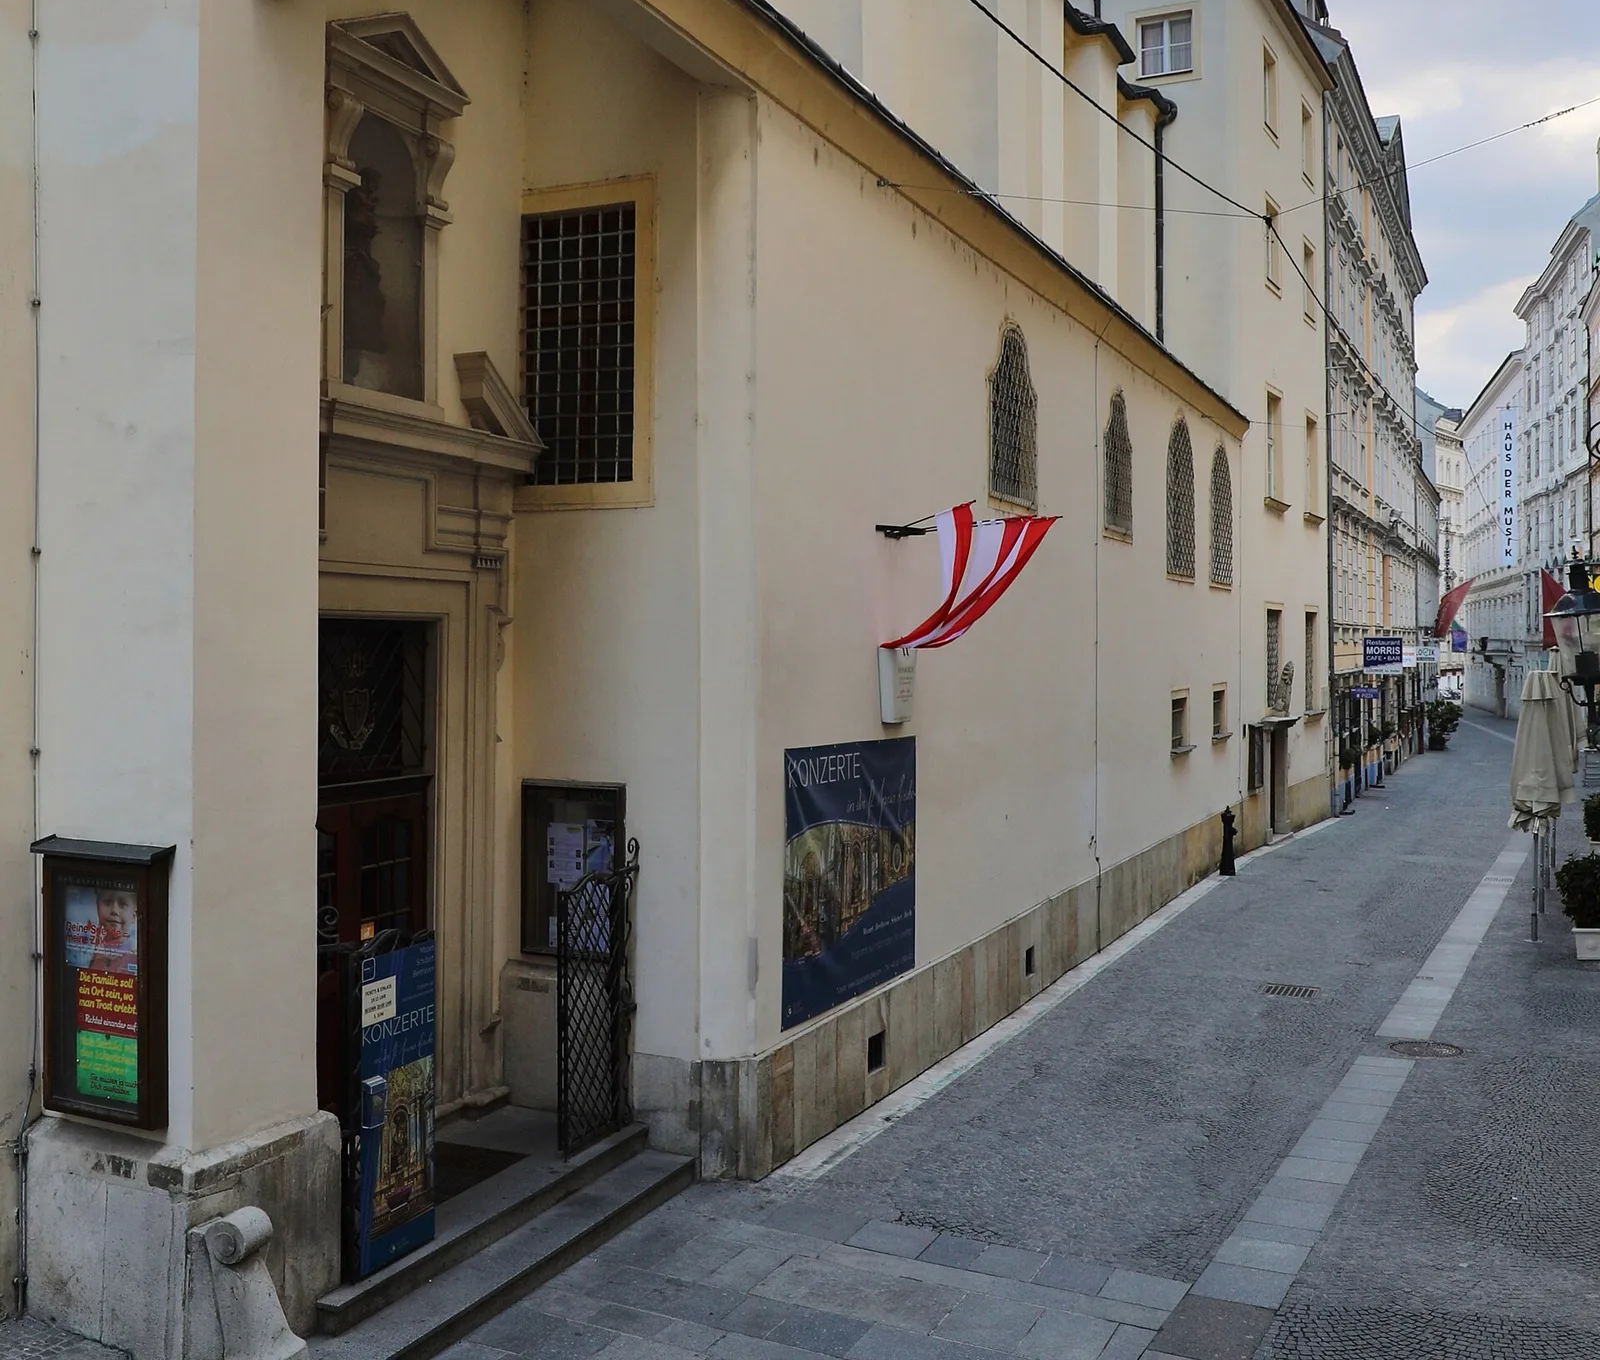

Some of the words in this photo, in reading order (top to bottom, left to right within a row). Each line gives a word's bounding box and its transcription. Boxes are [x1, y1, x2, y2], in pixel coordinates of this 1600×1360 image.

[1504, 422, 1512, 462] HAUS
[1504, 469, 1512, 498] DER
[1504, 507, 1513, 557] MUSIK
[1366, 646, 1400, 655] MORRIS
[788, 752, 860, 788] KONZERTE
[79, 985, 90, 995] ein
[91, 986, 104, 997] Ort
[105, 989, 122, 1001] sein,
[80, 972, 91, 982] Die
[92, 973, 119, 986] Familie
[120, 979, 134, 988] soll
[79, 999, 94, 1008] man
[96, 999, 112, 1010] Trost
[114, 1003, 137, 1015] erlebt.
[362, 1004, 434, 1046] KONZERTE
